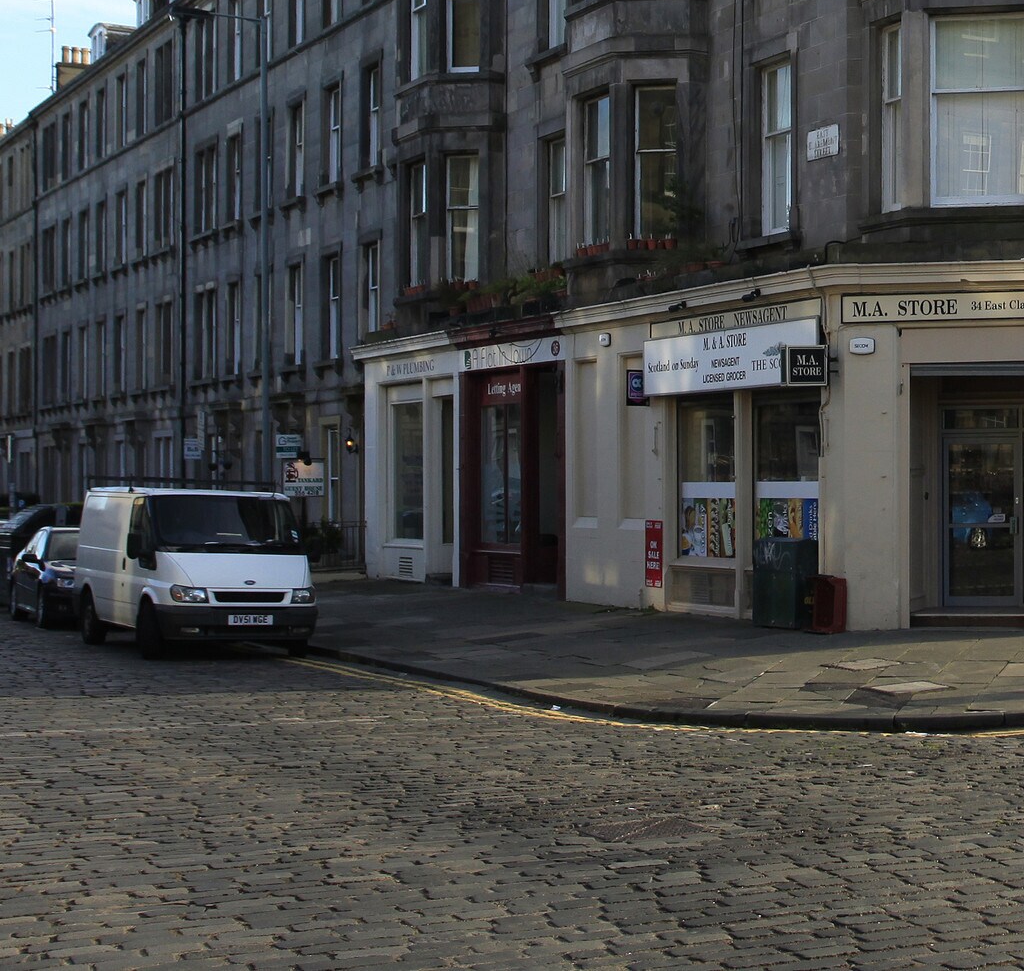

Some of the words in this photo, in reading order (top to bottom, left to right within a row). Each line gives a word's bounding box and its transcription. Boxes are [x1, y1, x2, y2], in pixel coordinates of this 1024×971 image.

[852, 301, 888, 318] M.A.
[897, 299, 958, 316] STORE
[971, 301, 982, 311] 34
[984, 300, 1006, 311] East
[699, 315, 725, 332] STORE
[733, 306, 788, 327] NEWSAGENT
[711, 337, 717, 349] &
[726, 333, 747, 348] STORE
[647, 359, 670, 373] Scotland
[672, 362, 679, 370] on
[680, 357, 699, 373] Sunday
[711, 357, 740, 368] NEWSAGENT
[752, 359, 767, 371] THE
[796, 354, 819, 365] M.A.
[403, 359, 435, 375] PLUMBING
[792, 367, 822, 376] STORE
[702, 373, 726, 383] LICENSED
[726, 371, 747, 382] GROCER
[487, 382, 506, 397] Letting
[648, 550, 660, 559] SALE
[646, 561, 661, 571] HERE
[233, 615, 251, 623] DV51
